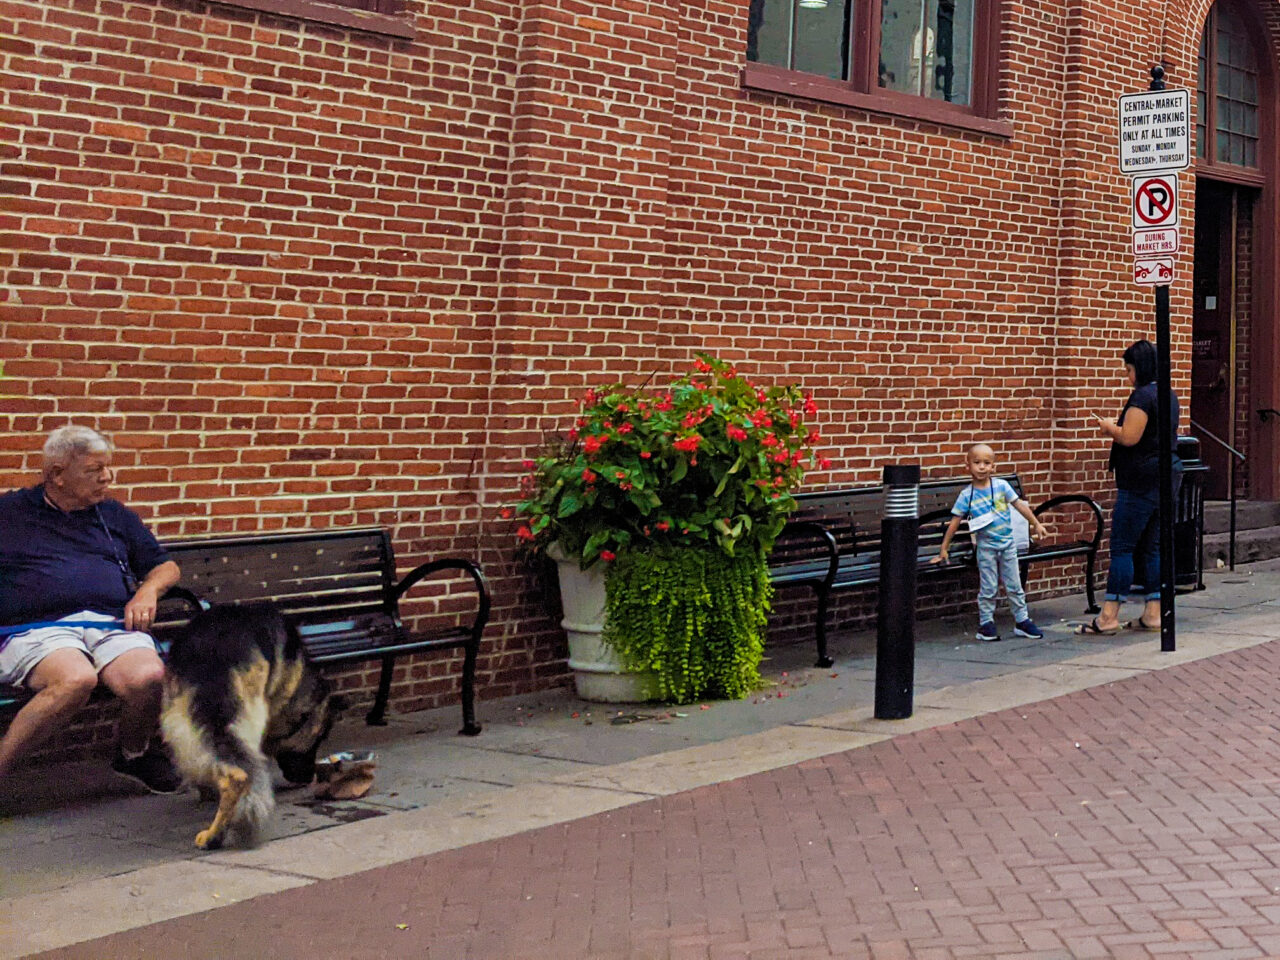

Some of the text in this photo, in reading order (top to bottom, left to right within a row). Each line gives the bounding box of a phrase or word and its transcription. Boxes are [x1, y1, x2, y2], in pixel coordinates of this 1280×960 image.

[1124, 97, 1183, 112] CENTRAL MARKET
[1123, 111, 1185, 127] PERMIT PARKING
[1122, 126, 1186, 142] ONLY AT ALL TIMES
[1155, 141, 1176, 150] MONDAY
[1159, 154, 1184, 163] THURSDAY
[1148, 187, 1168, 216] P
[1144, 233, 1166, 242] DURING
[1136, 242, 1160, 251] MARKET
